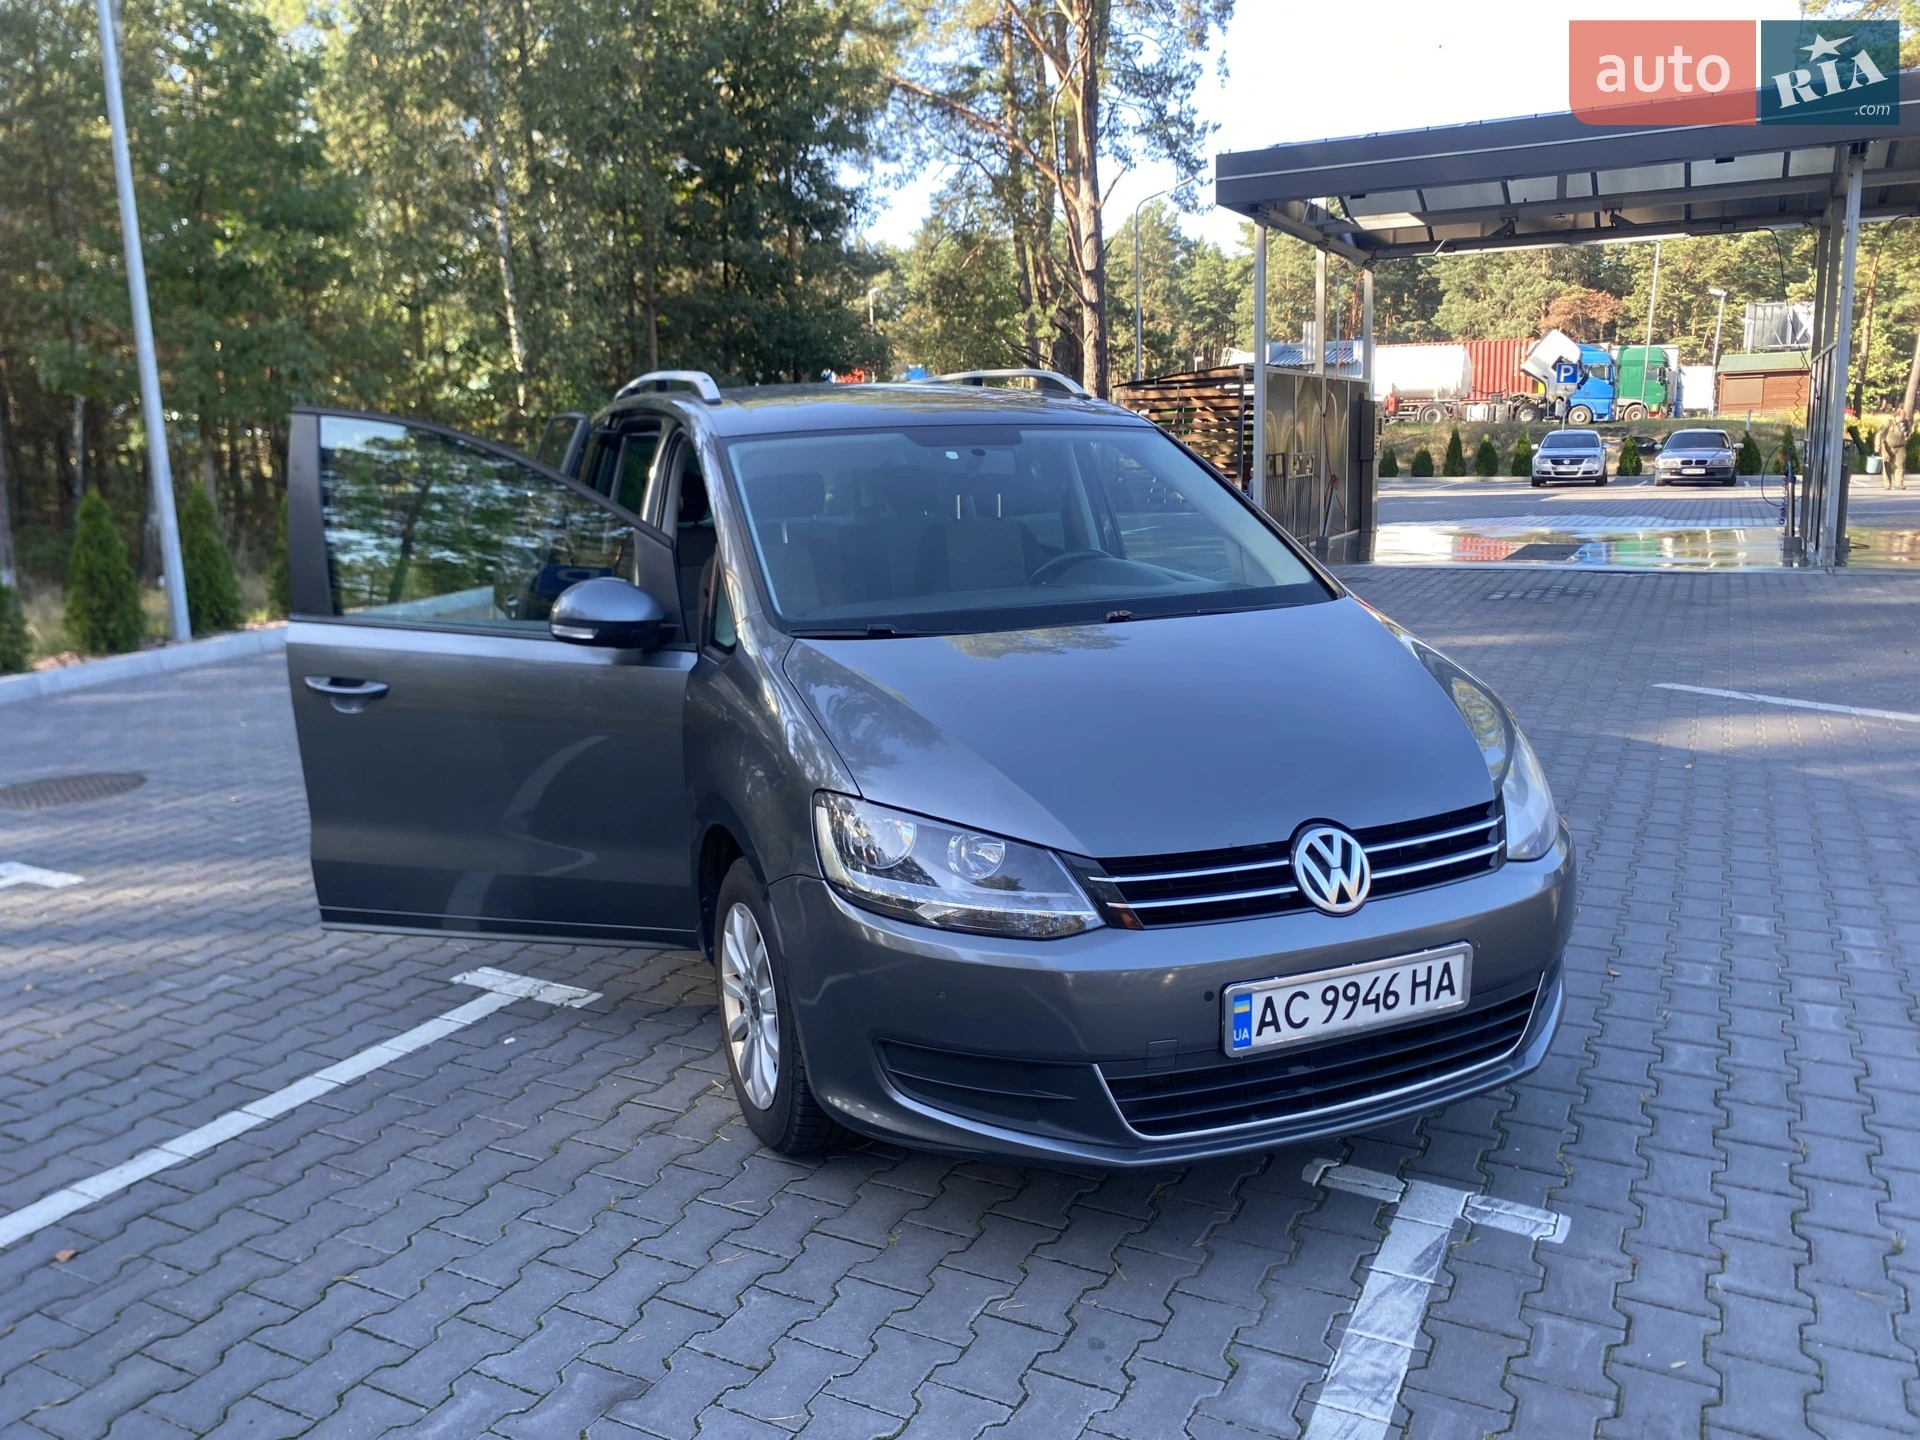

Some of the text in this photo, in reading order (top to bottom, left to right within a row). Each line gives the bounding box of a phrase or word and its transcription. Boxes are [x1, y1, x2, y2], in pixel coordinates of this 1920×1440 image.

[1560, 364, 1574, 382] P
[1299, 829, 1367, 909] VW
[1255, 961, 1456, 1037] AC 9946 HA
[1233, 1028, 1250, 1041] UA
